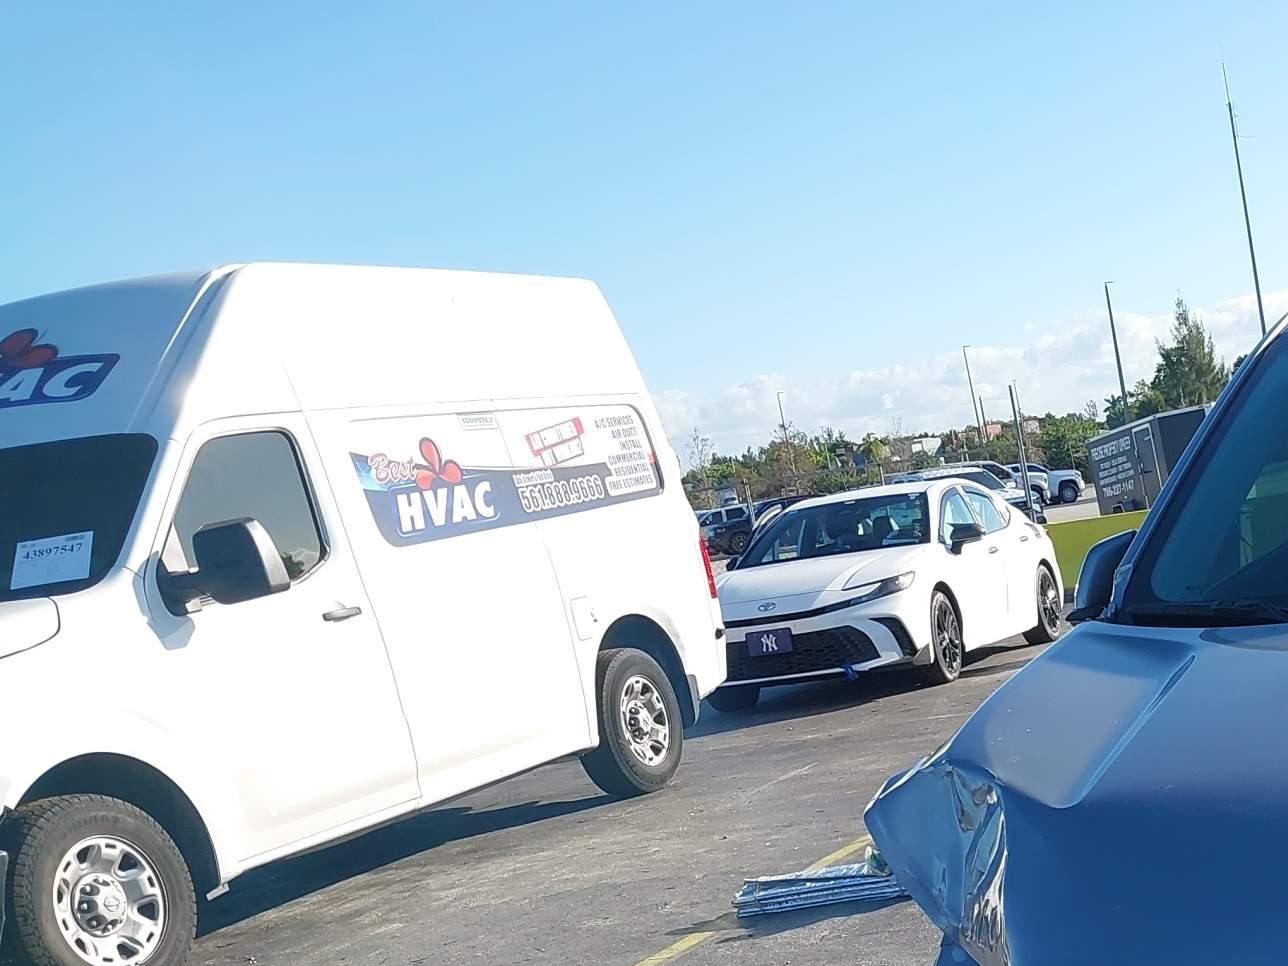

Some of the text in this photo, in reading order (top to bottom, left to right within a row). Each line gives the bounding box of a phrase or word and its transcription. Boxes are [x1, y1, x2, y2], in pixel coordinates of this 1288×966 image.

[0, 362, 104, 401] AC
[606, 414, 634, 427] SERVICES
[611, 426, 638, 439] AIR DUCT
[608, 450, 646, 465] COMMERCIAL
[368, 453, 418, 484] Best
[614, 462, 649, 477] RESIDENTIAL
[623, 474, 653, 489] ESTIMATES
[397, 481, 495, 533] HVAC
